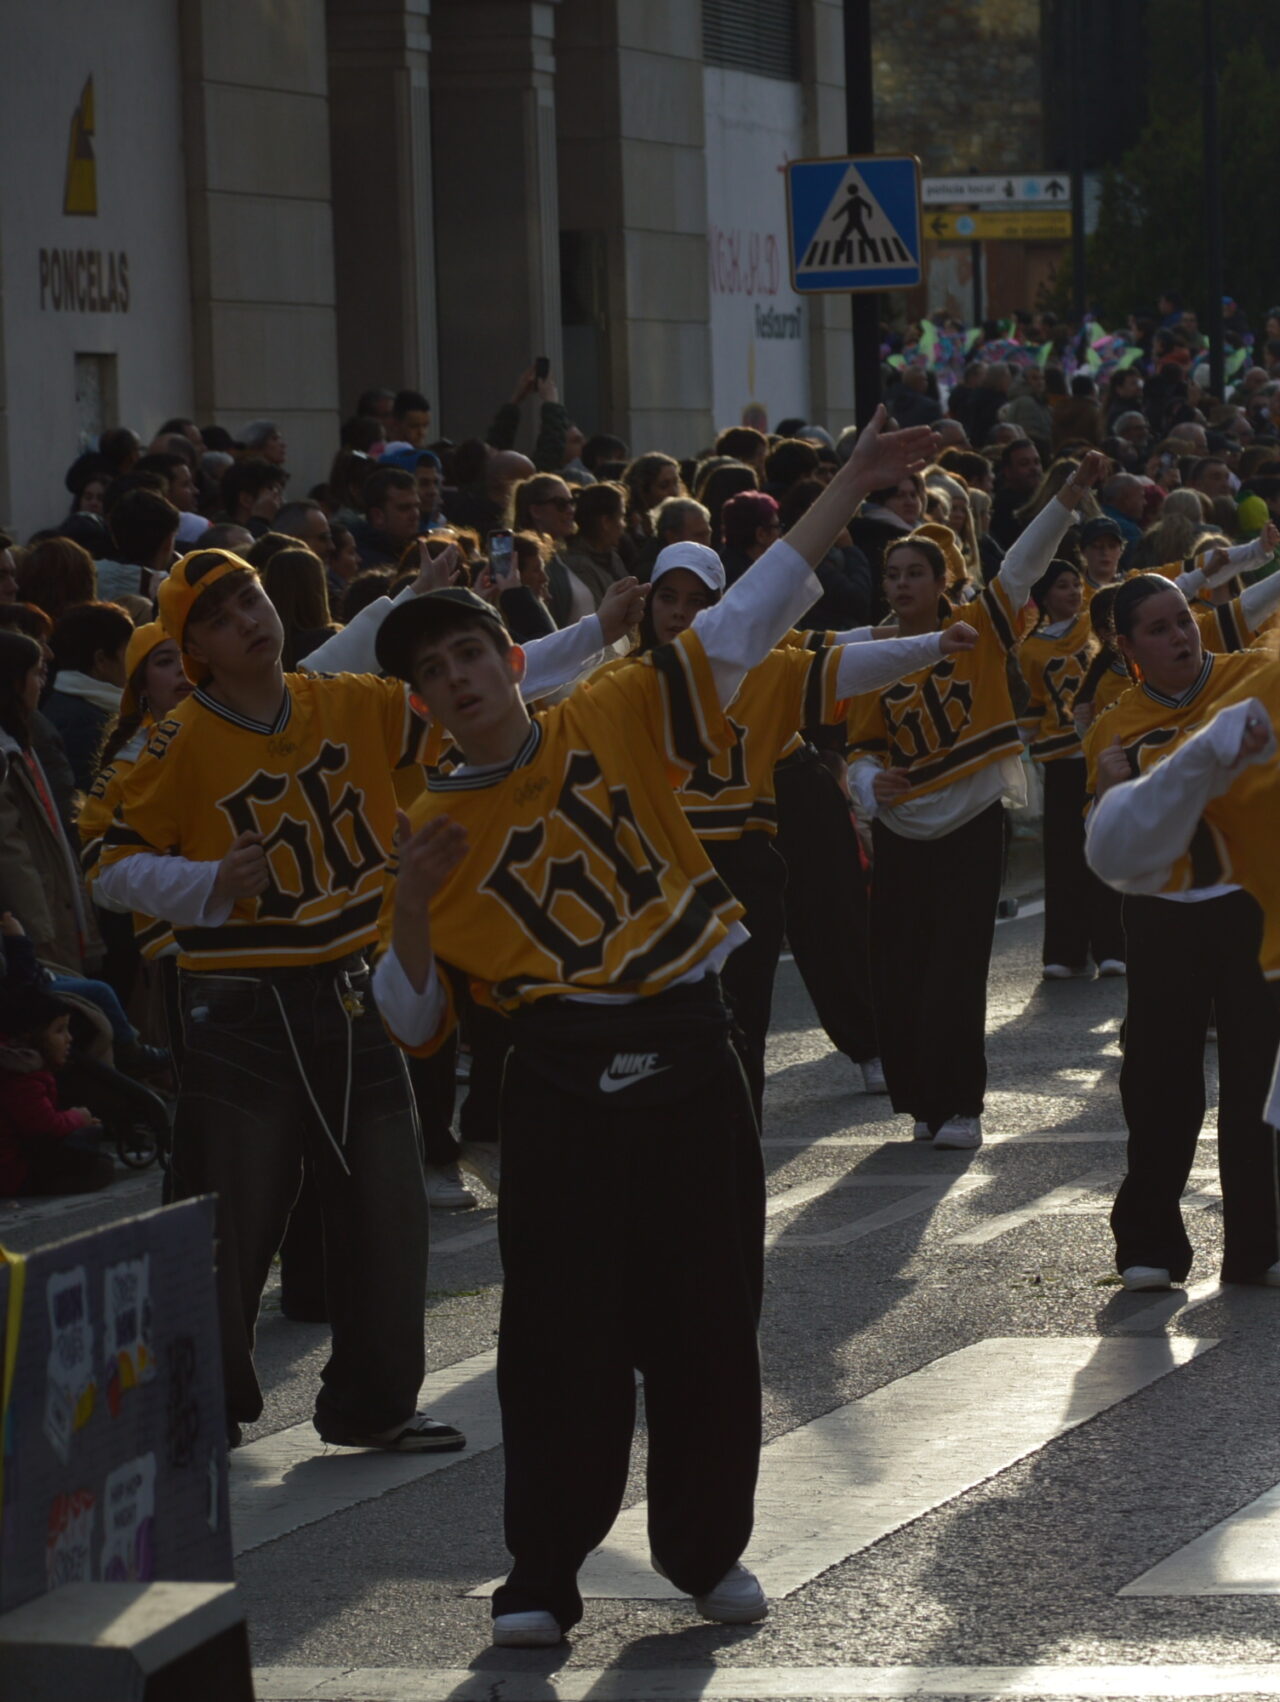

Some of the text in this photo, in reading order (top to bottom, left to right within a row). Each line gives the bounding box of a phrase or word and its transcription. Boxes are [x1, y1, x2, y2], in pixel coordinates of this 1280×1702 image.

[39, 247, 130, 313] PONCELAS
[215, 738, 391, 923] 66
[609, 1052, 659, 1075] NIKE
